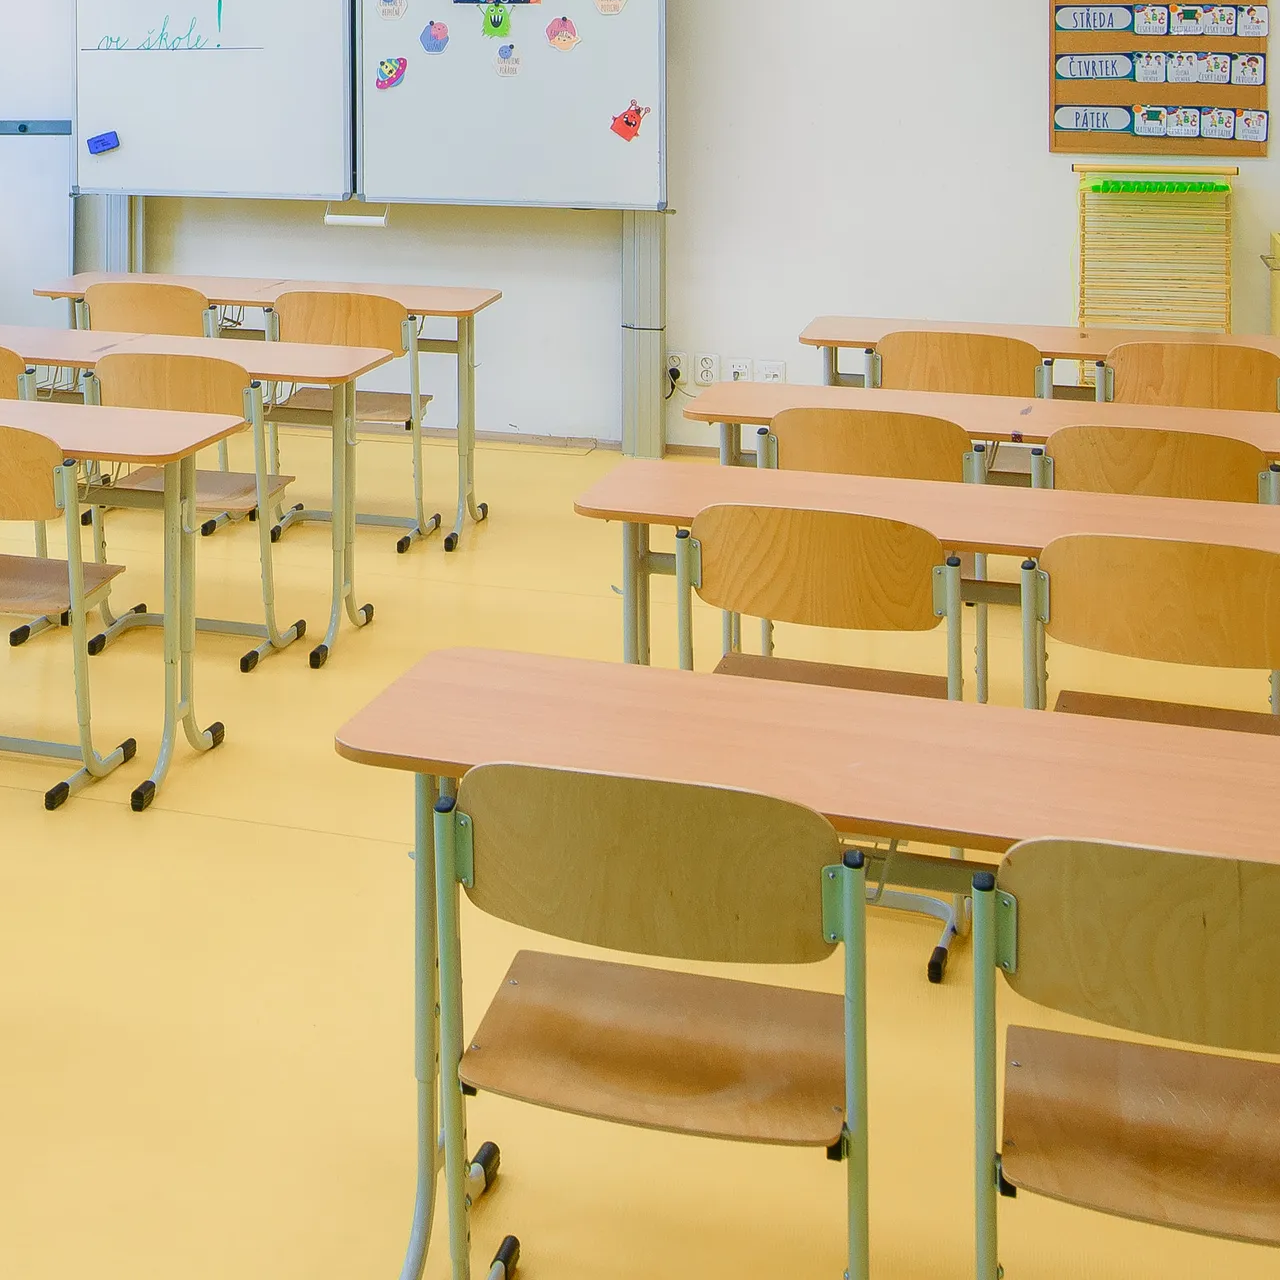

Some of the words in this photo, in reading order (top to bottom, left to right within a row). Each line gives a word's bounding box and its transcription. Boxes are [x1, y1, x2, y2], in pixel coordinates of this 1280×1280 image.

[1073, 7, 1114, 28] STŘEDA
[97, 35, 129, 50] ve
[1069, 56, 1118, 77] ČTVRTEK
[1075, 108, 1109, 129] PÁTEK
